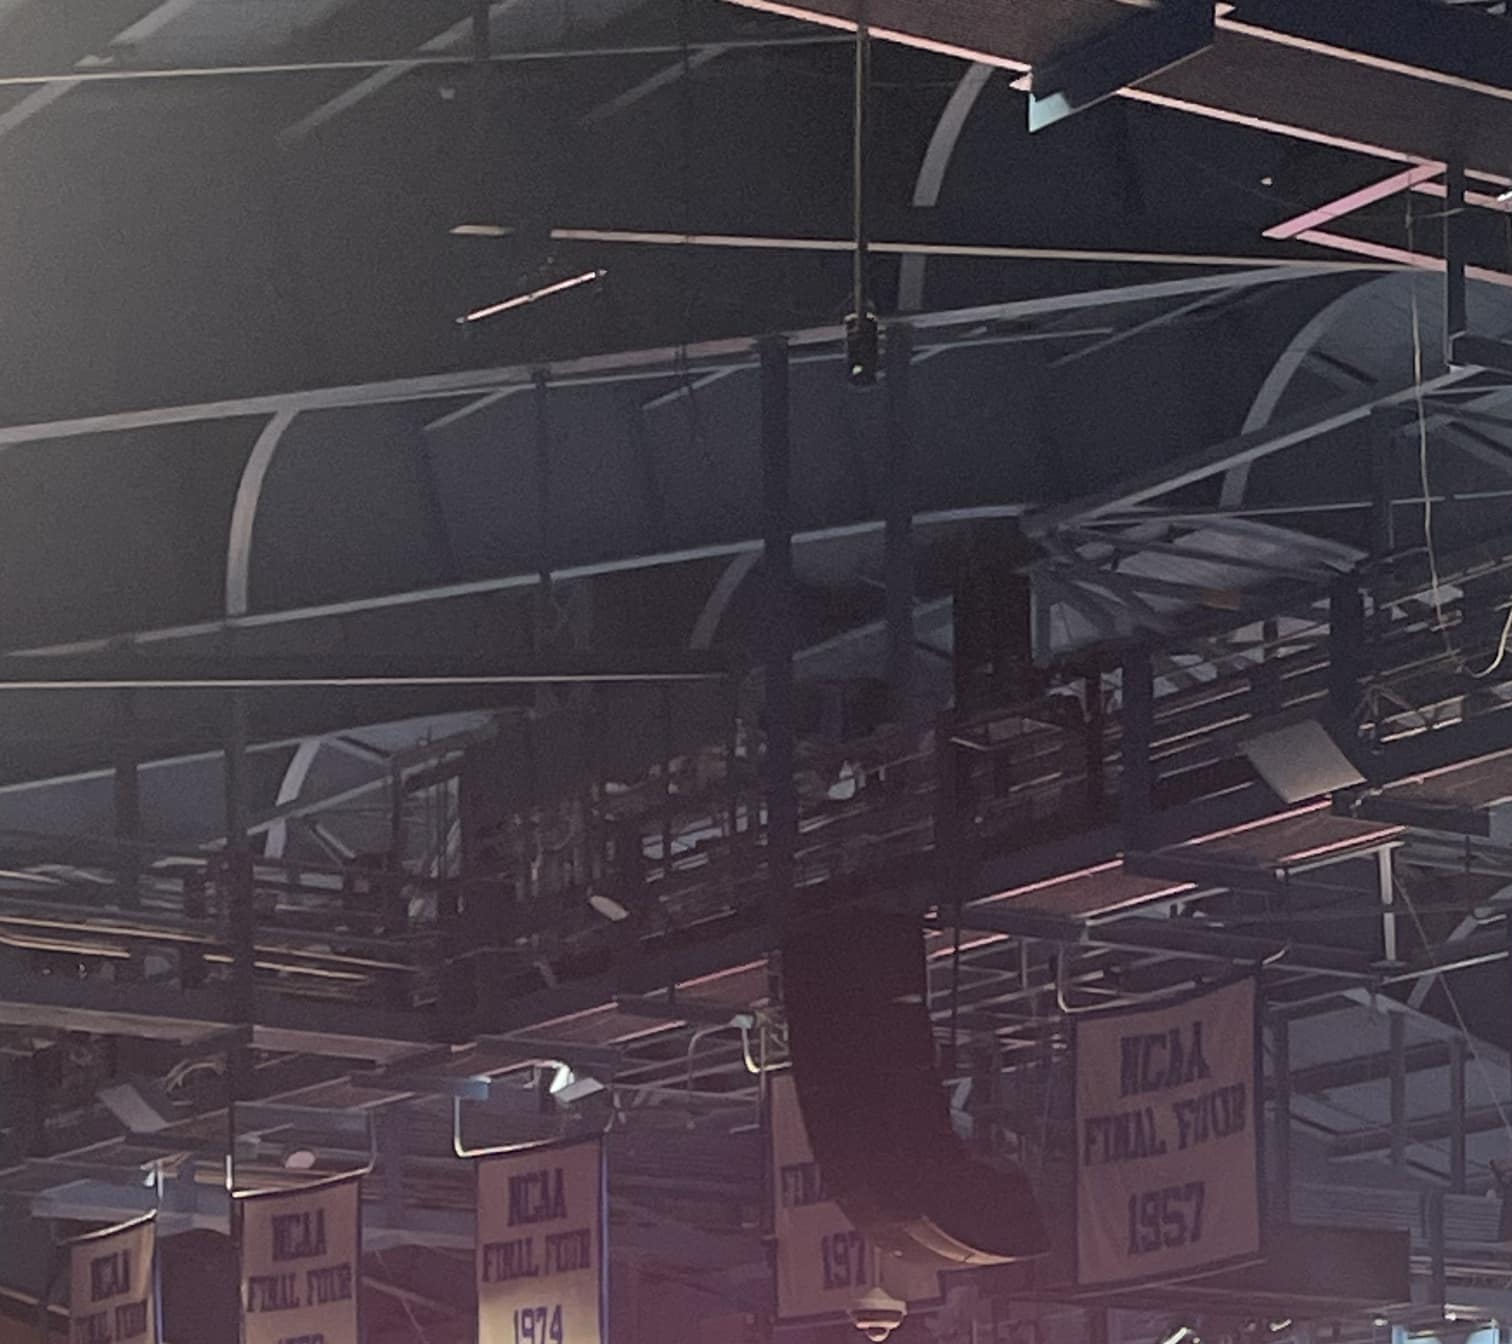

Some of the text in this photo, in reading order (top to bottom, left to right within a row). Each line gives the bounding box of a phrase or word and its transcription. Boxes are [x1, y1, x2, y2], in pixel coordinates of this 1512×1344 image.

[1119, 1020, 1211, 1098] NCAA
[1084, 1082, 1249, 1167] FINAL FOUR
[507, 1167, 568, 1227] NCAA
[1127, 1181, 1206, 1256] 1957
[270, 1208, 327, 1262] NCAA
[482, 1227, 591, 1283] FINAL FOUR
